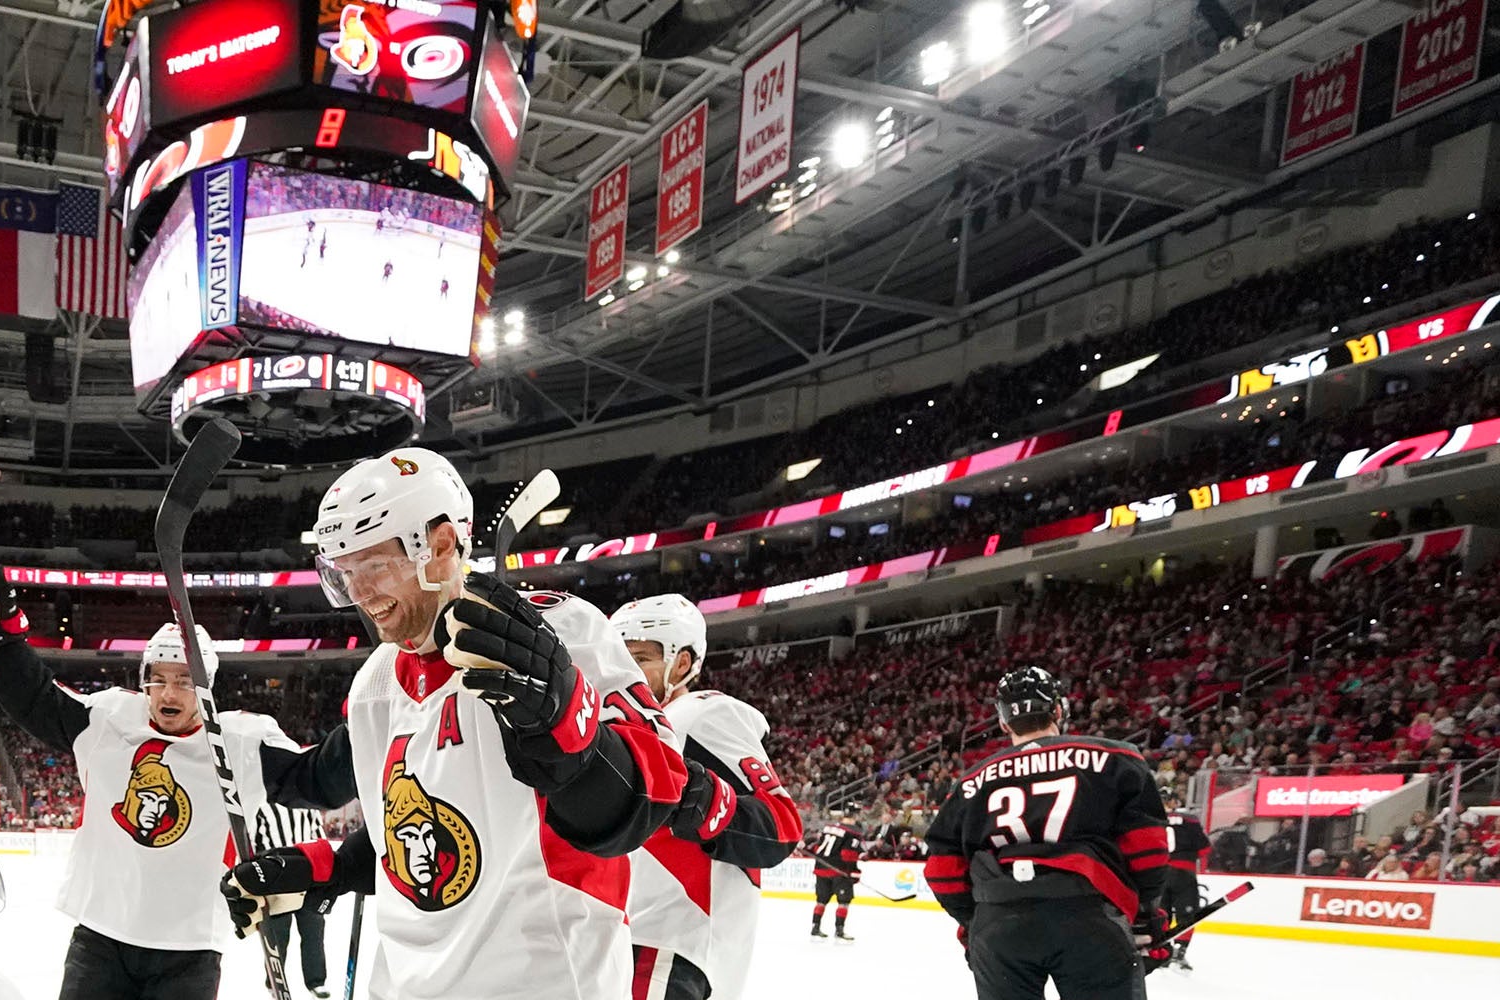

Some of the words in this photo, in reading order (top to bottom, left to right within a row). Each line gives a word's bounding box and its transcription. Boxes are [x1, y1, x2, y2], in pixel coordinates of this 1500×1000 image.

[166, 44, 218, 75] TODAY'S
[219, 26, 281, 60] MATCHUP
[1416, 16, 1467, 70] 2013
[753, 61, 786, 116] 1974
[1301, 75, 1347, 123] 2012
[669, 117, 697, 161] ACC
[745, 115, 786, 157] NATIONAL
[661, 145, 704, 194] CHAMPIONS
[739, 142, 788, 189] CHAMPIONS
[207, 168, 231, 237] WRAL
[596, 173, 621, 214] ACC
[590, 203, 627, 241] CHAMPIONS
[209, 244, 229, 323] NEWS
[1418, 318, 1444, 339] VS
[1245, 474, 1269, 495] VS
[318, 522, 343, 536] CCM
[436, 693, 464, 751] A
[1011, 699, 1032, 716] 37
[194, 685, 245, 817] CCM
[738, 756, 781, 791] 8
[961, 748, 1110, 800] SVECHNIKOV
[987, 774, 1078, 849] 37
[1309, 892, 1423, 921] Lenovo
